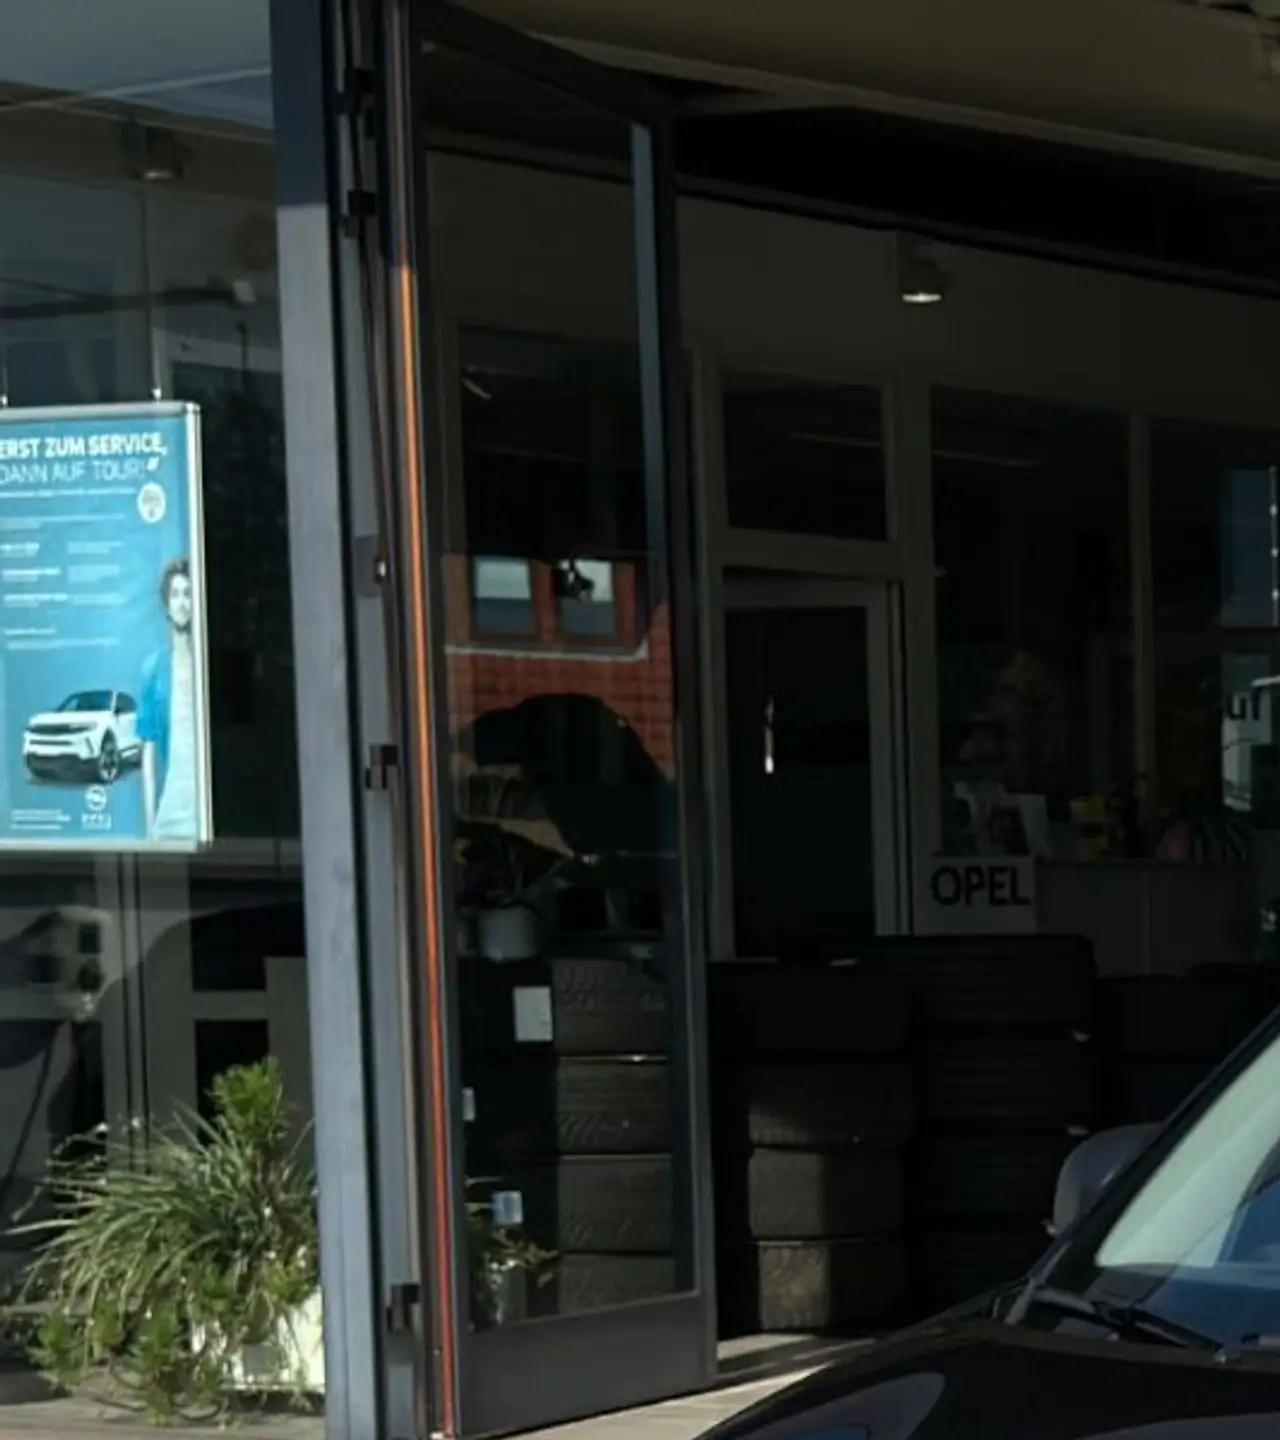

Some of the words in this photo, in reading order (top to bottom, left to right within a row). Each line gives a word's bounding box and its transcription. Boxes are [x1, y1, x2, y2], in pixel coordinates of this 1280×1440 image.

[44, 435, 86, 458] ZUM
[52, 459, 86, 482] AUF
[930, 866, 1032, 907] OPEL
